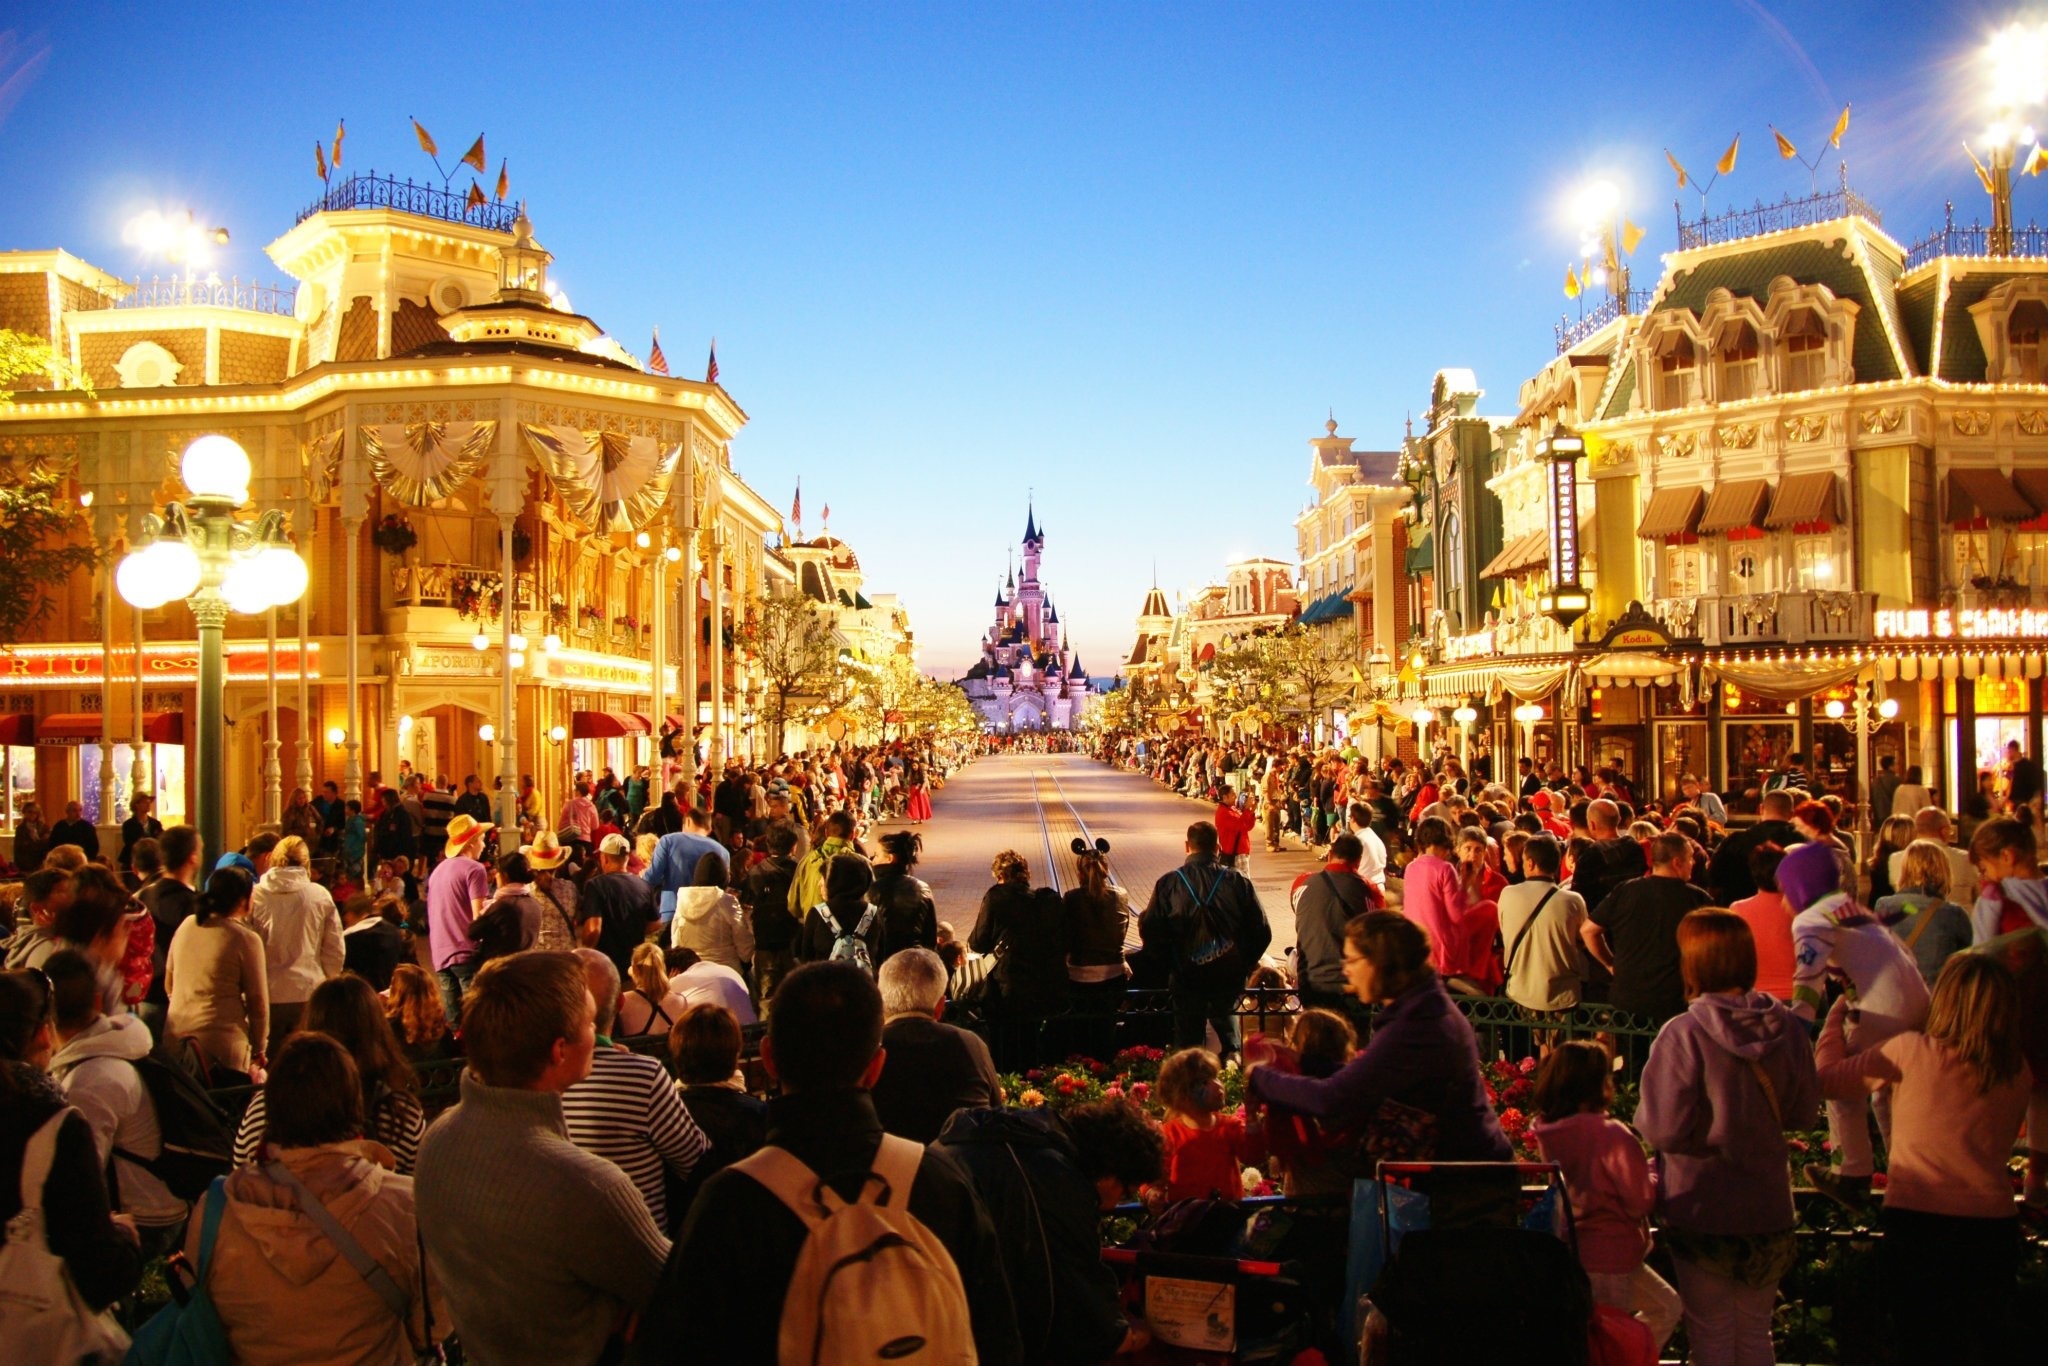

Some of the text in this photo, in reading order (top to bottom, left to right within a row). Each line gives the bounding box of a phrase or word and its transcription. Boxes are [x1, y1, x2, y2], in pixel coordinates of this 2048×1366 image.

[1558, 463, 1573, 583] PHOTOGRAPHY
[1874, 609, 1928, 637] FILM
[1622, 634, 1652, 644] Kodak
